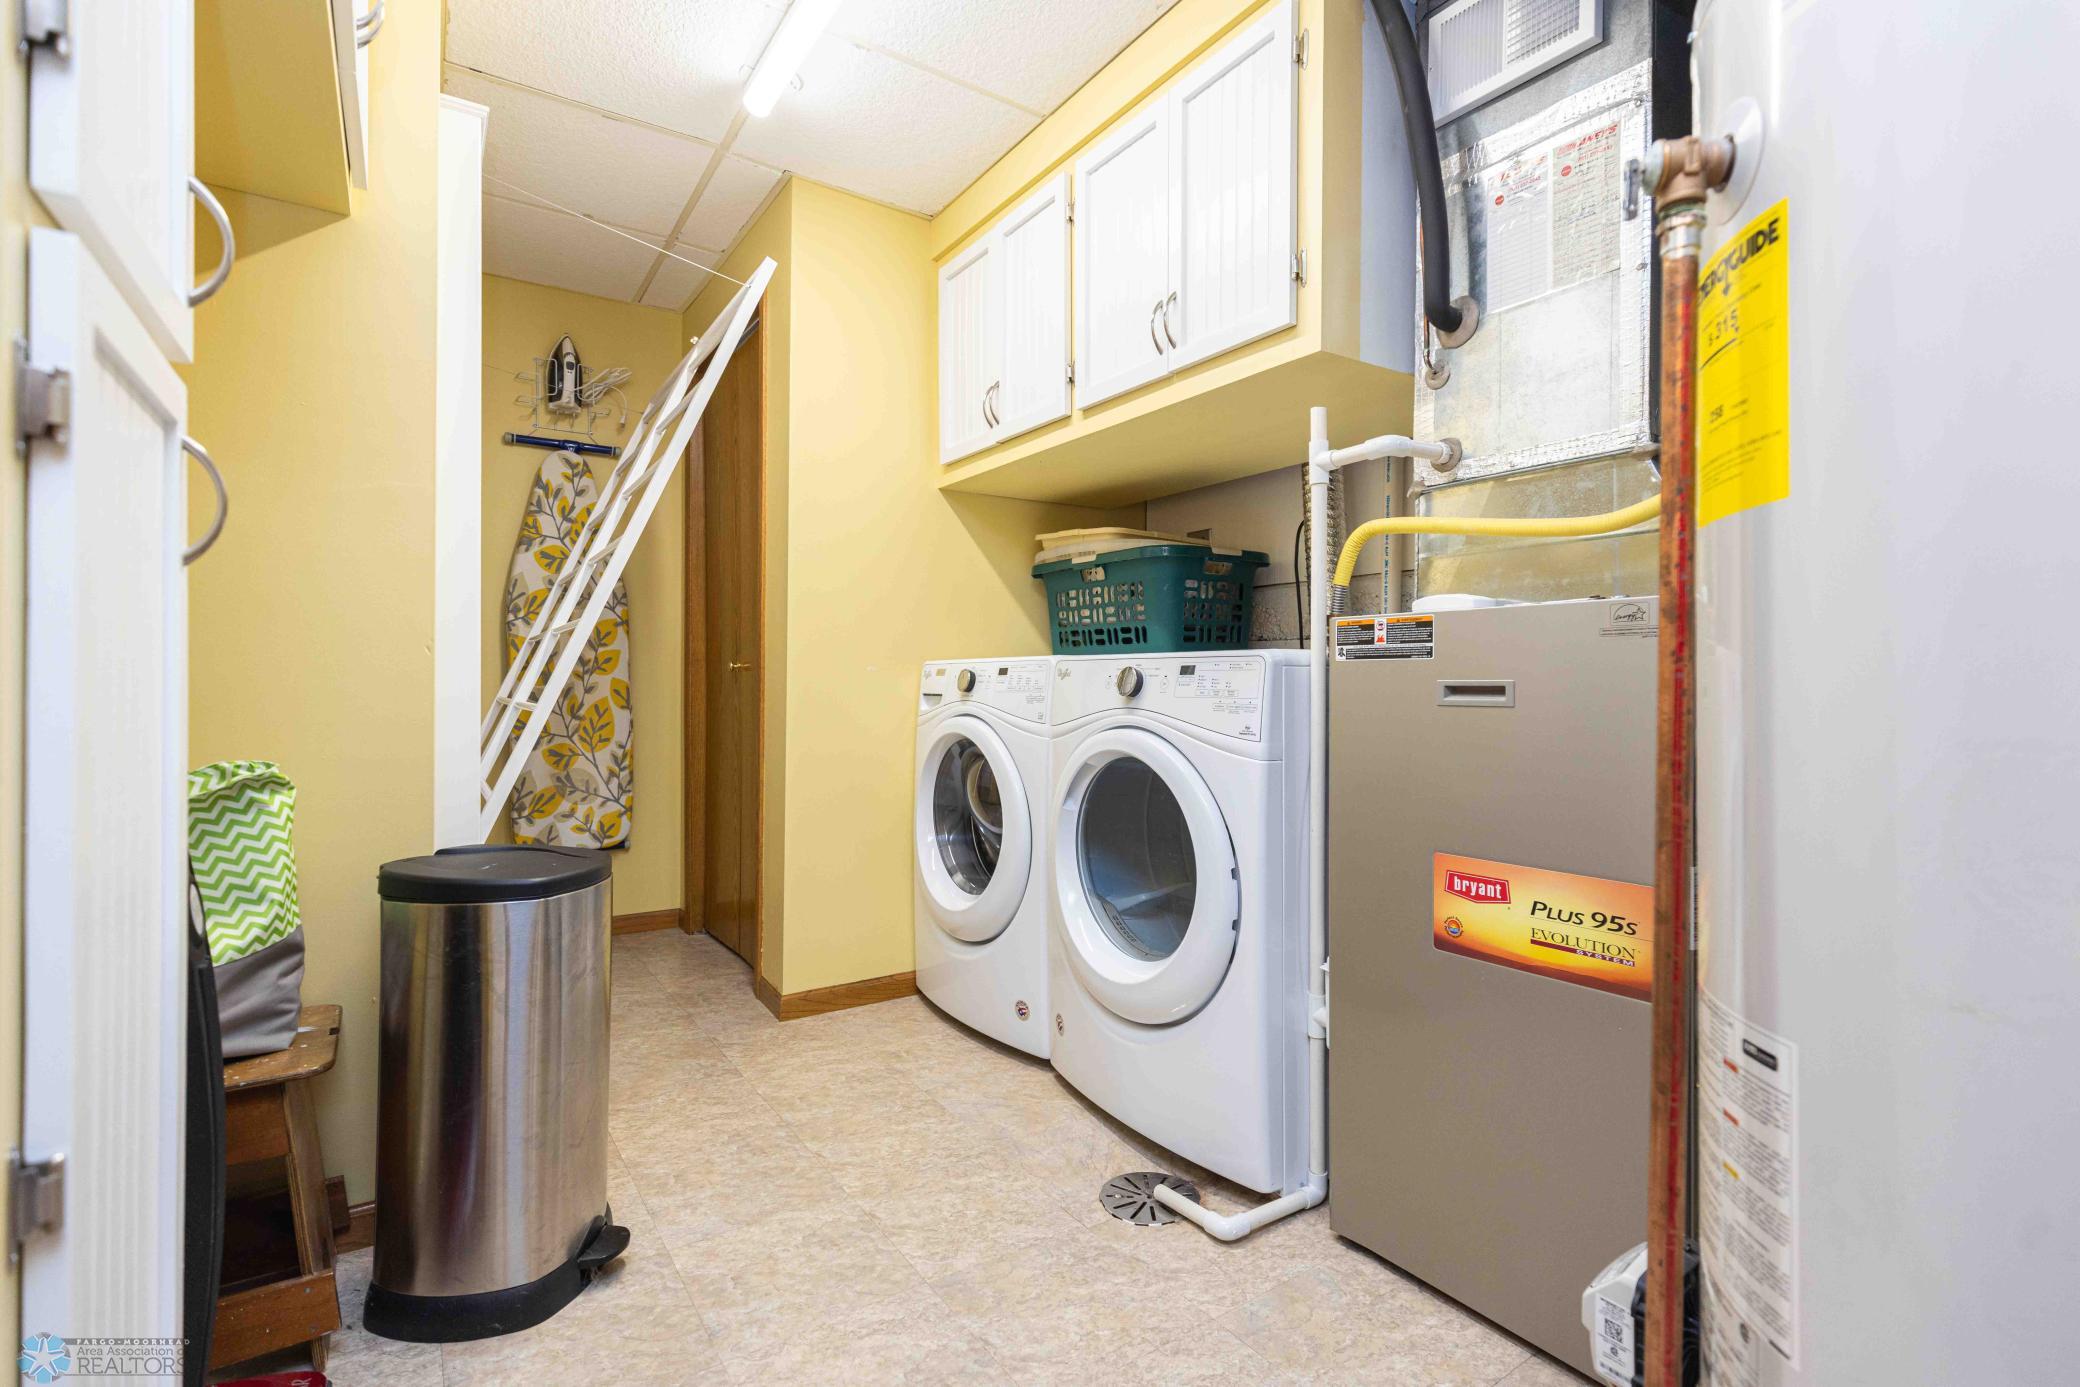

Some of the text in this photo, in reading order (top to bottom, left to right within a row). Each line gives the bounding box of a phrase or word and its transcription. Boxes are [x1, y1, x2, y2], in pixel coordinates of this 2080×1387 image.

[1453, 876, 1502, 900] bryant
[1531, 927, 1635, 960] EVOLUTION
[1576, 949, 1635, 968] SYSTEM
